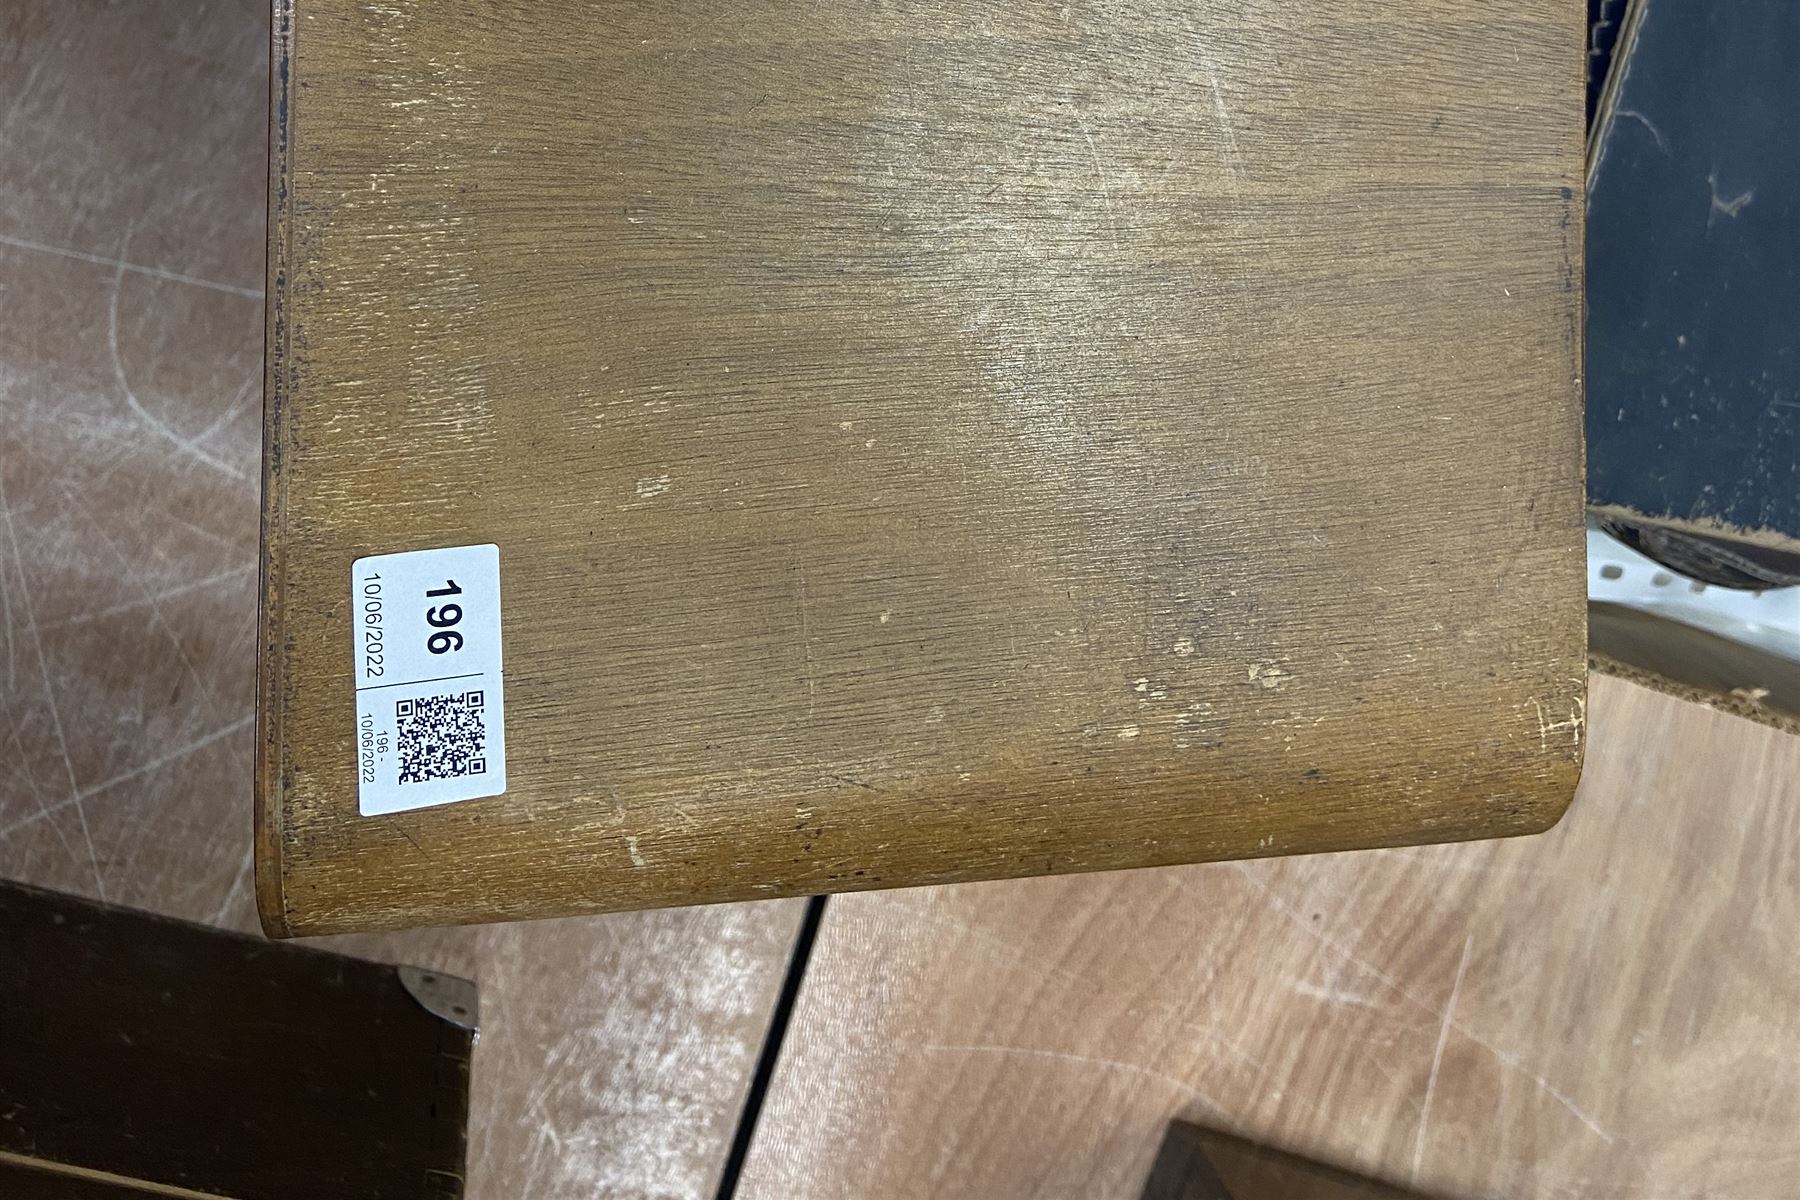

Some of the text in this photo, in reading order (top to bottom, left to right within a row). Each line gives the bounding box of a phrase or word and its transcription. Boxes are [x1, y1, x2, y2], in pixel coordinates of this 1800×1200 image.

[364, 572, 384, 678] 10/06/2022
[426, 579, 464, 655] 196
[361, 712, 375, 784] 10/06/2022
[376, 730, 389, 754] 196
